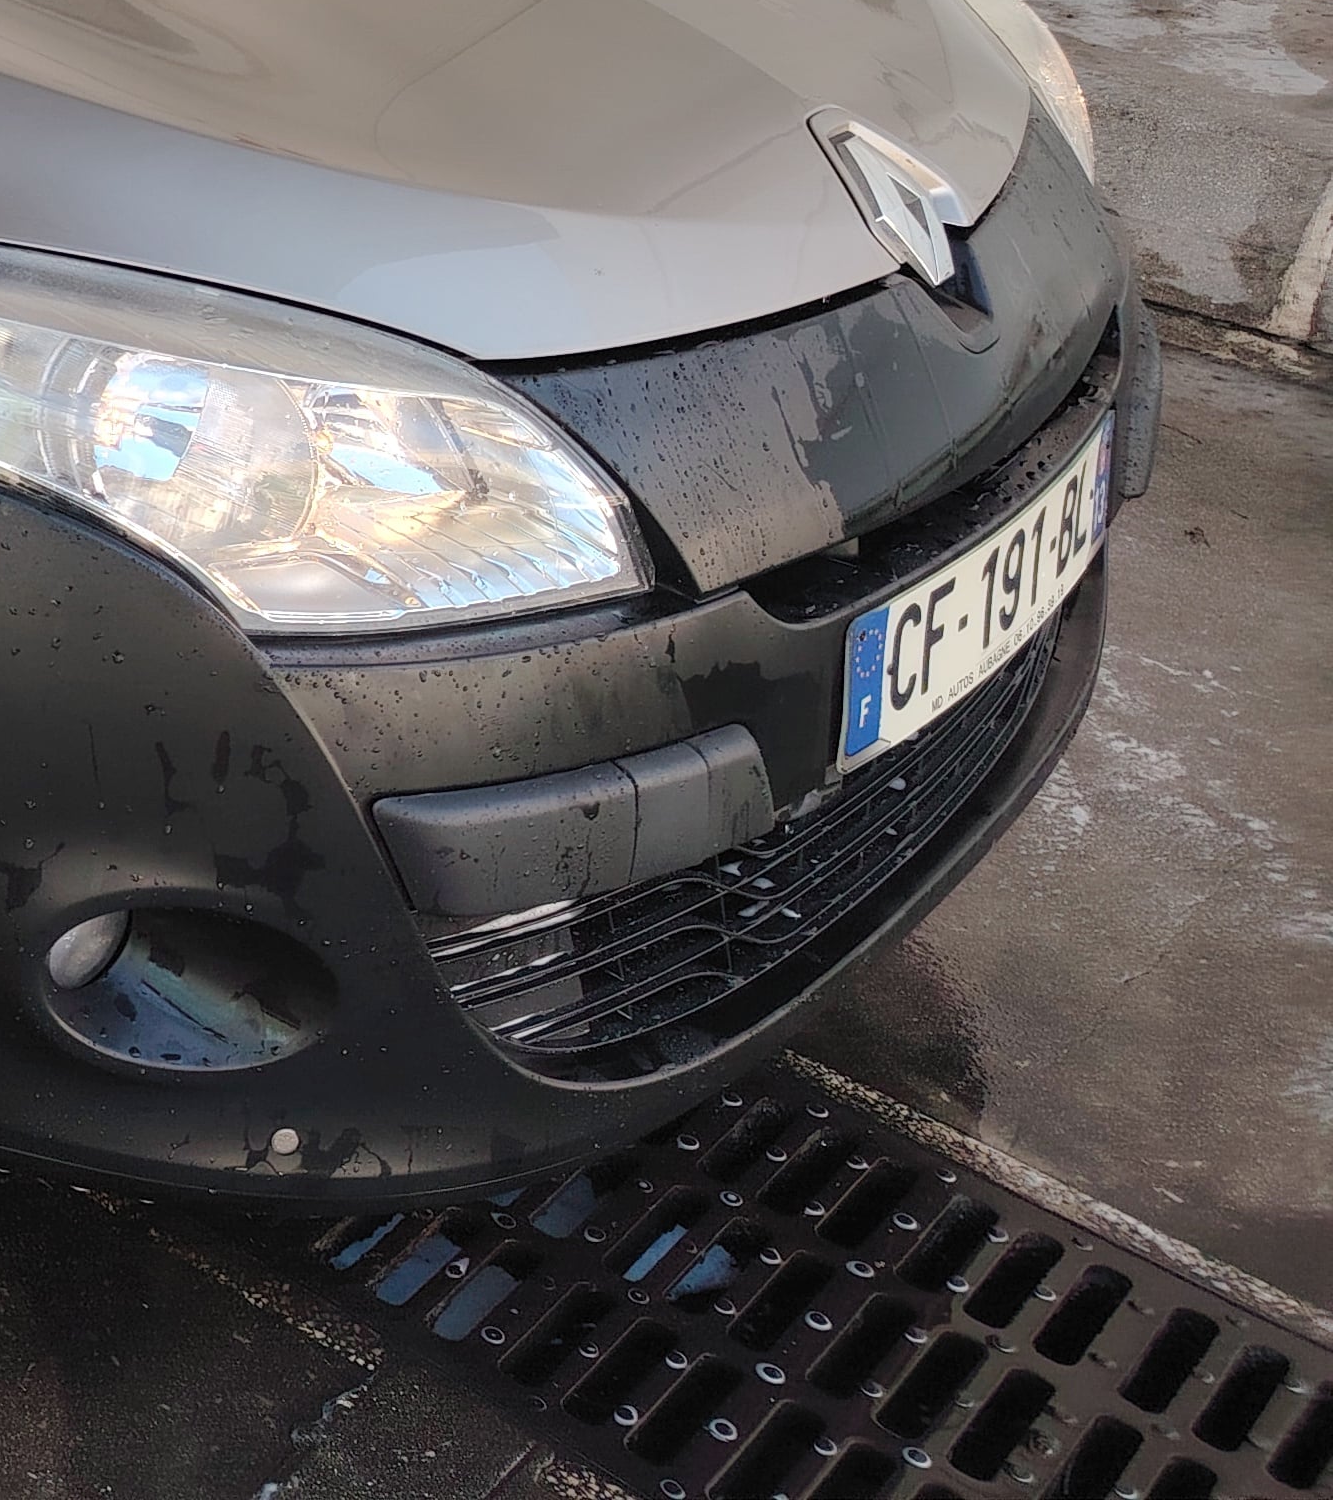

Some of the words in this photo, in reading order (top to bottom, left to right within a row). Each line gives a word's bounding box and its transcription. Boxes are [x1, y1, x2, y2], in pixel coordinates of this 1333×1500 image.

[1094, 483, 1106, 529] 13
[890, 459, 1088, 712] CF-191-BL
[948, 671, 974, 700] AUTOS
[978, 641, 1011, 679] AUBAGNE
[858, 694, 873, 729] F
